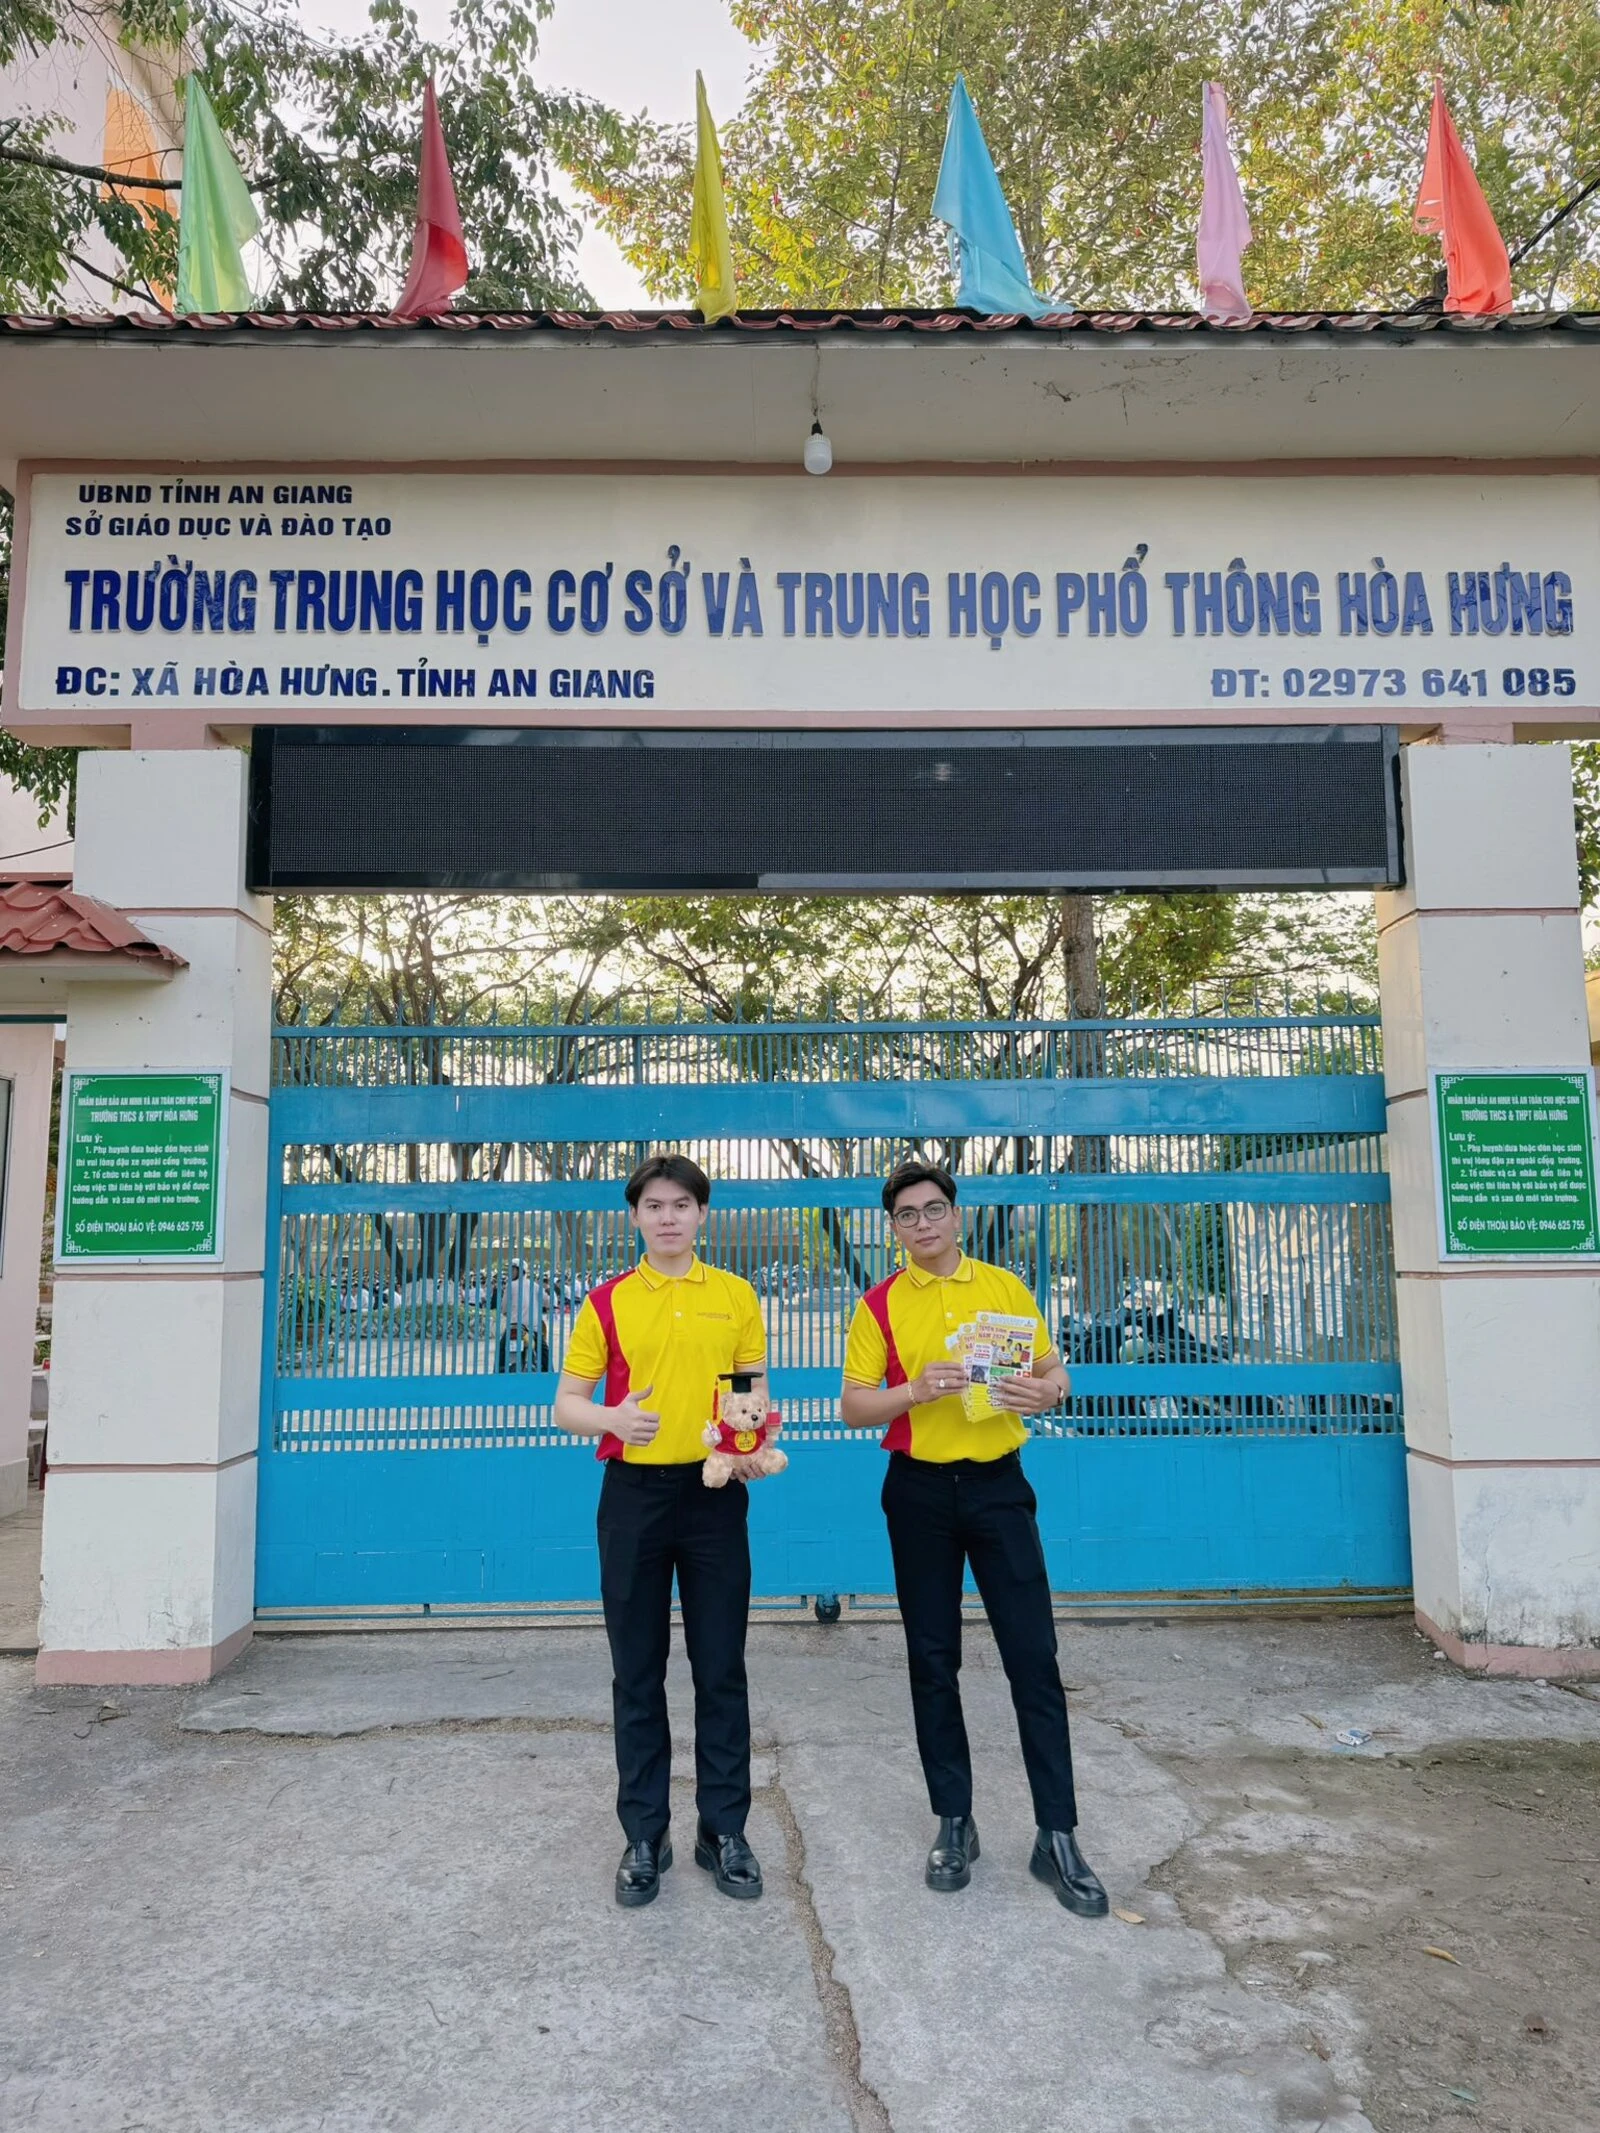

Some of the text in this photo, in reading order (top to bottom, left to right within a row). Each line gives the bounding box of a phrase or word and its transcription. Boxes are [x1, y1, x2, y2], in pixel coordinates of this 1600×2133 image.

[79, 476, 354, 505] UBND TỈNH AN GIANG
[65, 508, 392, 541] SỞ GIÁO DỤC VÀ ĐÀO TẠO
[64, 543, 1576, 650] TRƯỜNG TRUNG HỌC CƠ SỞ VÀ TRUNG HỌC PHỔ THÔNG HÒA HƯNG
[55, 666, 119, 698] ĐC:
[131, 661, 181, 698] XÃ
[194, 661, 270, 698] HÒA
[488, 668, 539, 699] AN
[548, 668, 656, 700] GIANG
[1211, 668, 1577, 699] ĐT: 02973 641 085
[120, 1112, 136, 1122] THCS
[146, 1111, 162, 1122] THPT
[1489, 1111, 1506, 1121] THCS
[1515, 1111, 1532, 1121] THPT
[75, 1219, 85, 1233] SỐ
[87, 1220, 103, 1235] ĐIỆN
[105, 1222, 126, 1235] THOẠI
[128, 1219, 144, 1232] BẢO
[158, 1222, 175, 1232] 0946
[177, 1221, 190, 1231] 625
[192, 1221, 204, 1231] 755
[1457, 1217, 1467, 1230] SỐ
[1469, 1218, 1485, 1233] ĐIỆN
[1487, 1220, 1509, 1233] THOẠI
[1510, 1217, 1525, 1230] BẢO
[1539, 1220, 1556, 1230] 0946
[1558, 1220, 1571, 1230] 625
[1572, 1220, 1585, 1230] 755
